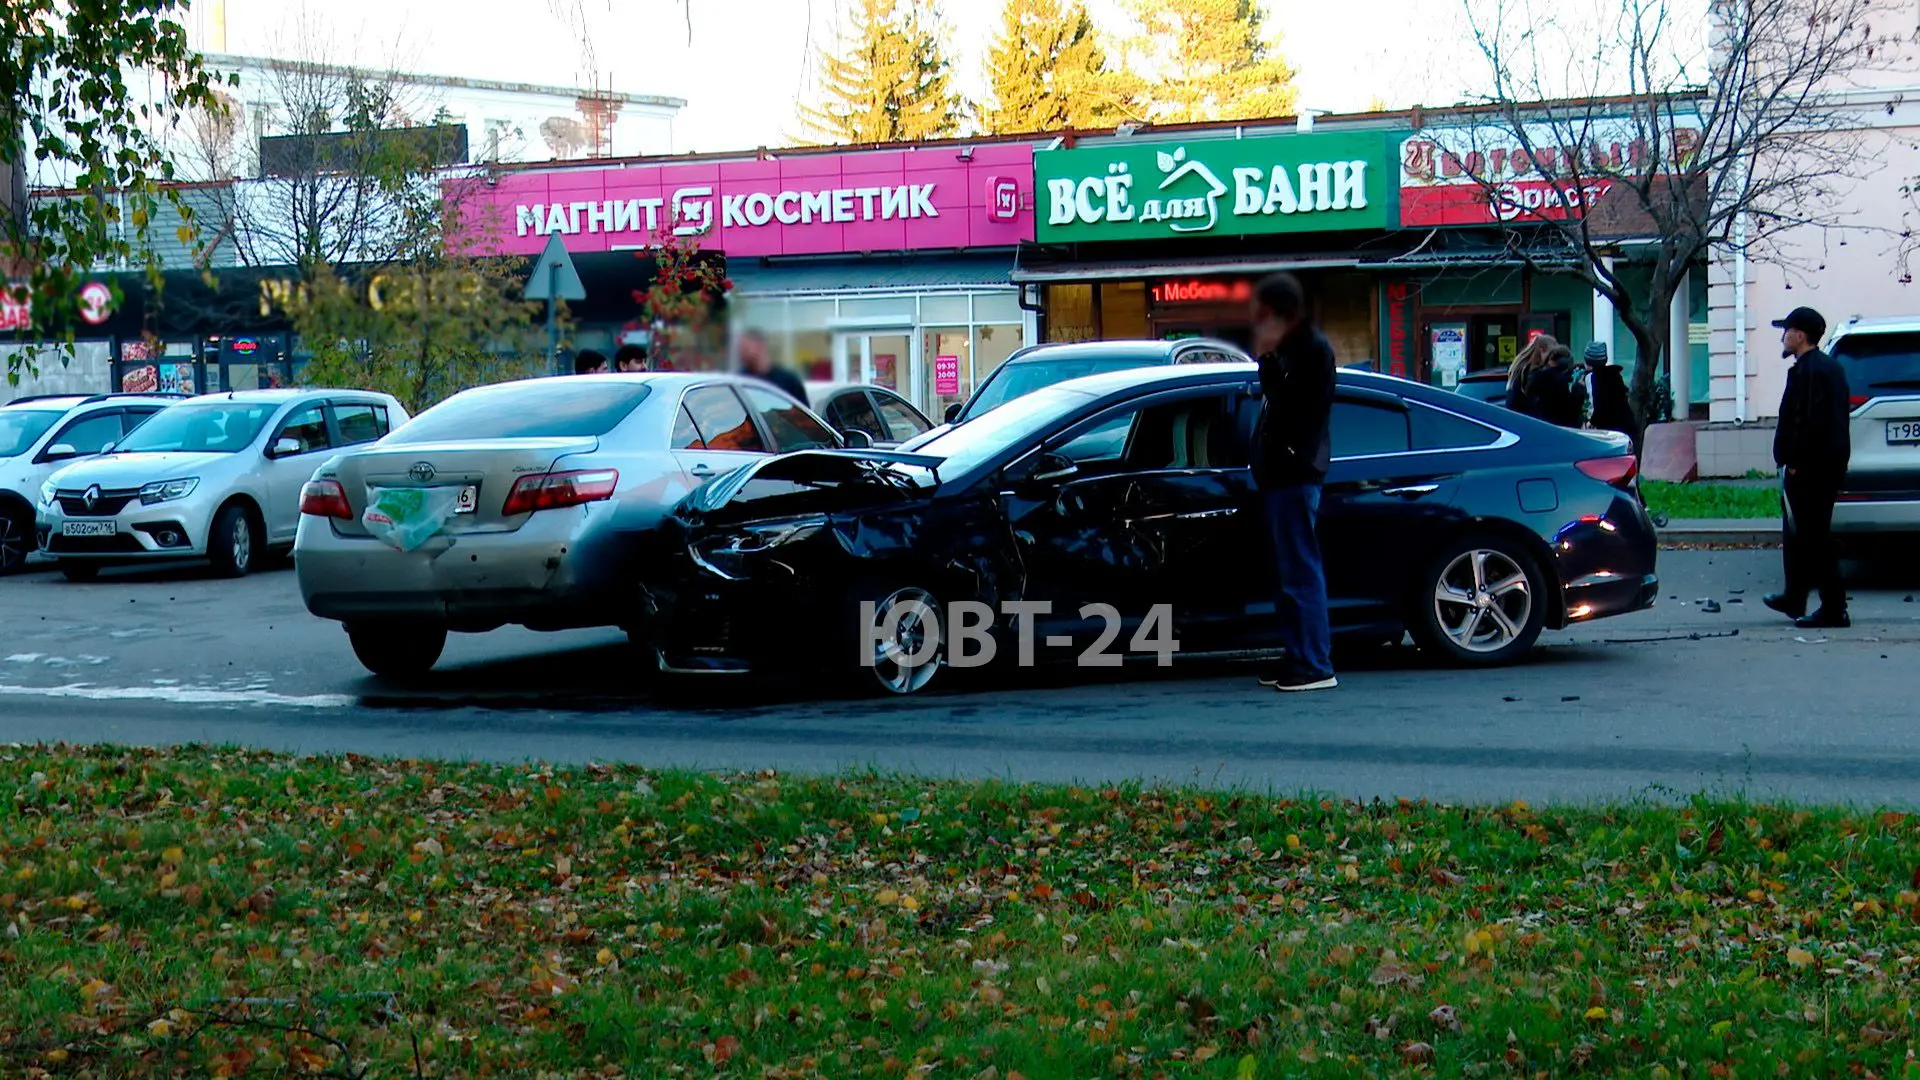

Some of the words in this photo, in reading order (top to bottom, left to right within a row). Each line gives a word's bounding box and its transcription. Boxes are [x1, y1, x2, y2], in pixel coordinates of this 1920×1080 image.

[516, 197, 664, 237] МАГНИТ
[721, 183, 939, 228] КОСМЕТИК
[1047, 162, 1135, 225] ВСЁ
[1139, 197, 1206, 223] для
[1232, 160, 1369, 215] БАНИ
